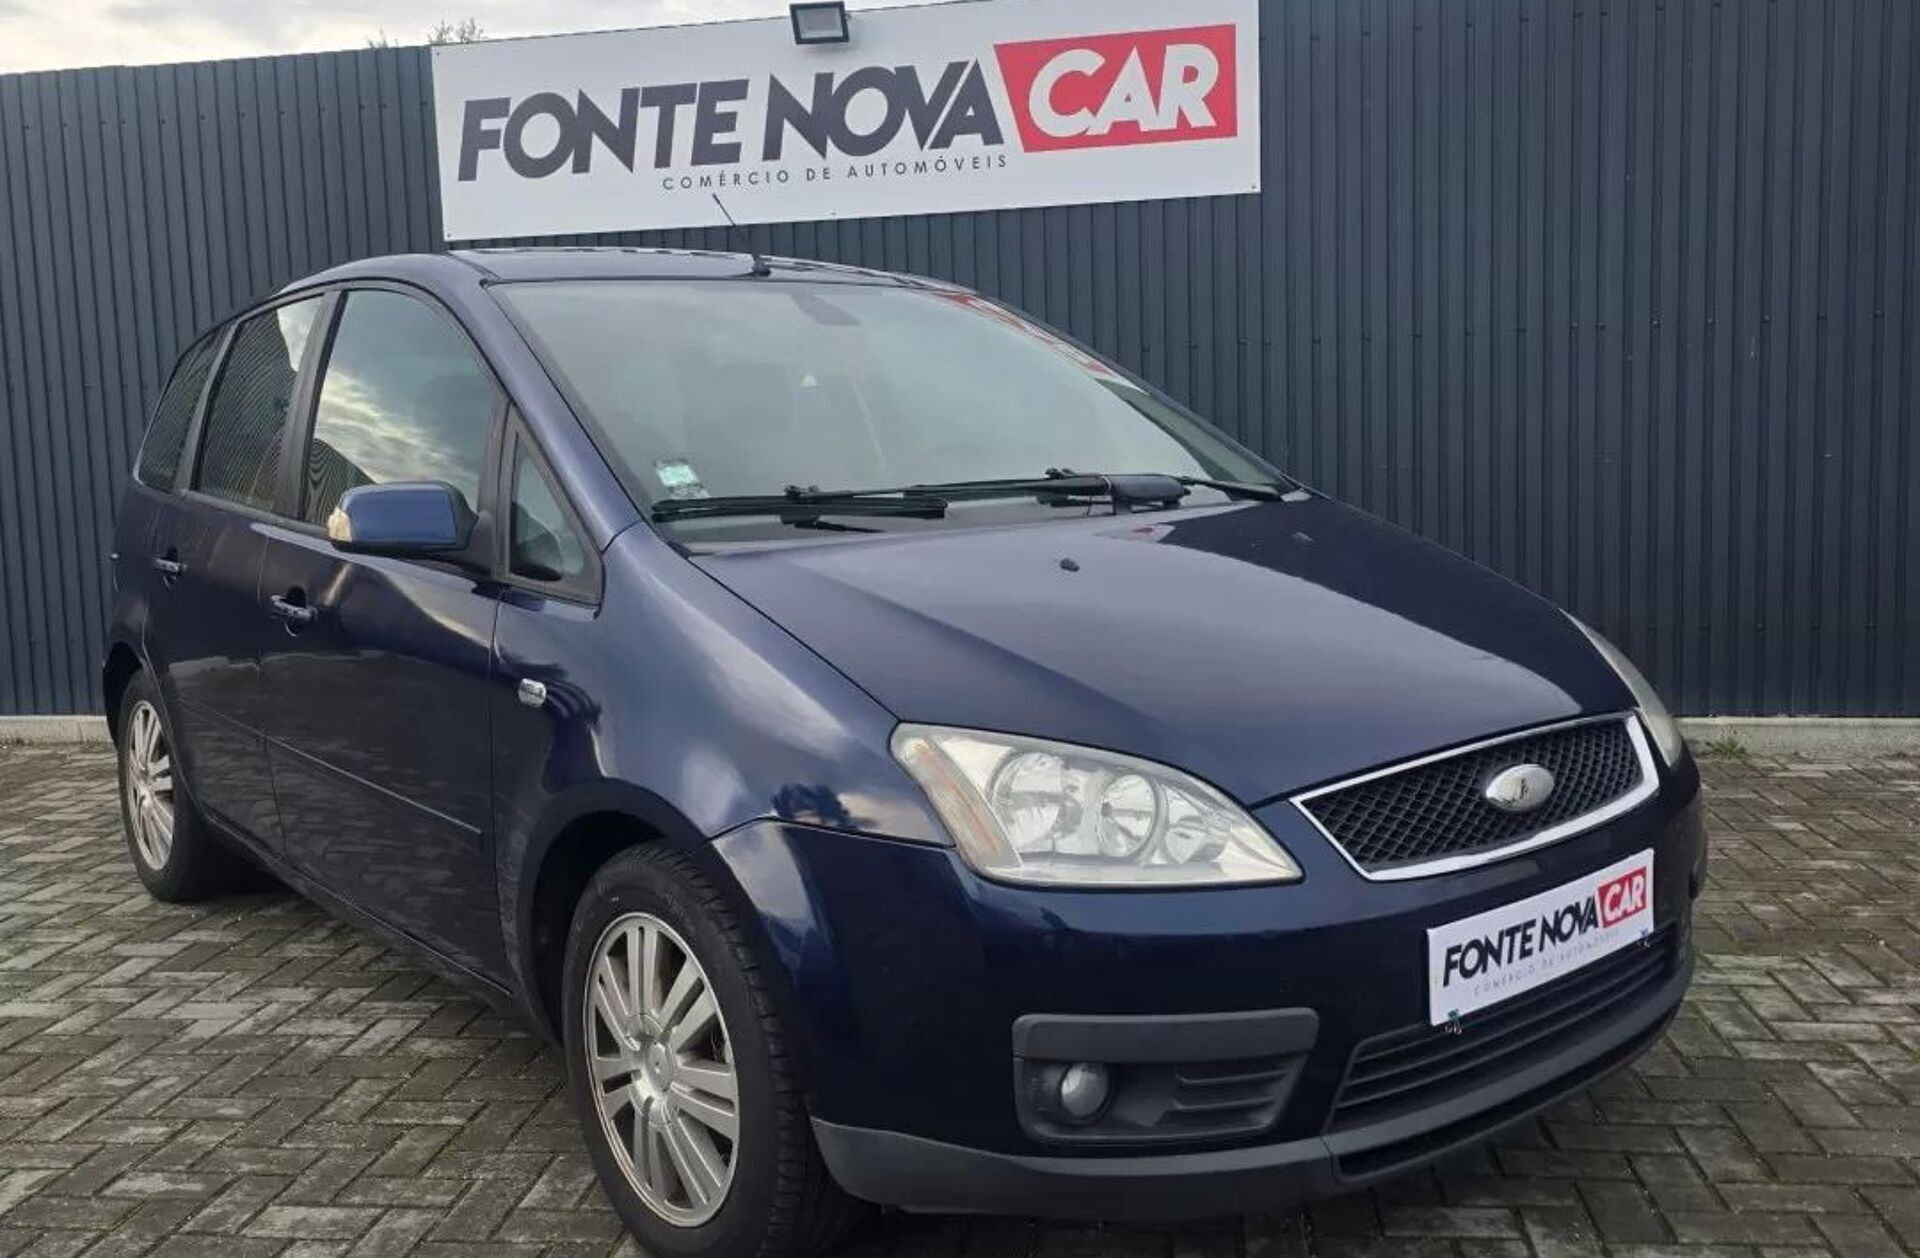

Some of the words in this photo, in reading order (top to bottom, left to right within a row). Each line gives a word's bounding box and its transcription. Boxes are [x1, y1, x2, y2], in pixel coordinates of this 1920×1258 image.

[458, 79, 749, 181] FONTE
[762, 57, 1004, 161] NOVA
[1029, 43, 1219, 138] CAR
[663, 169, 789, 190] COMÉRCIO
[807, 165, 831, 182] DE
[847, 155, 1008, 178] AUTOMÓVEIS
[1443, 918, 1537, 987] FONTE
[1539, 894, 1599, 952] NOVA
[1604, 875, 1644, 922] CAR
